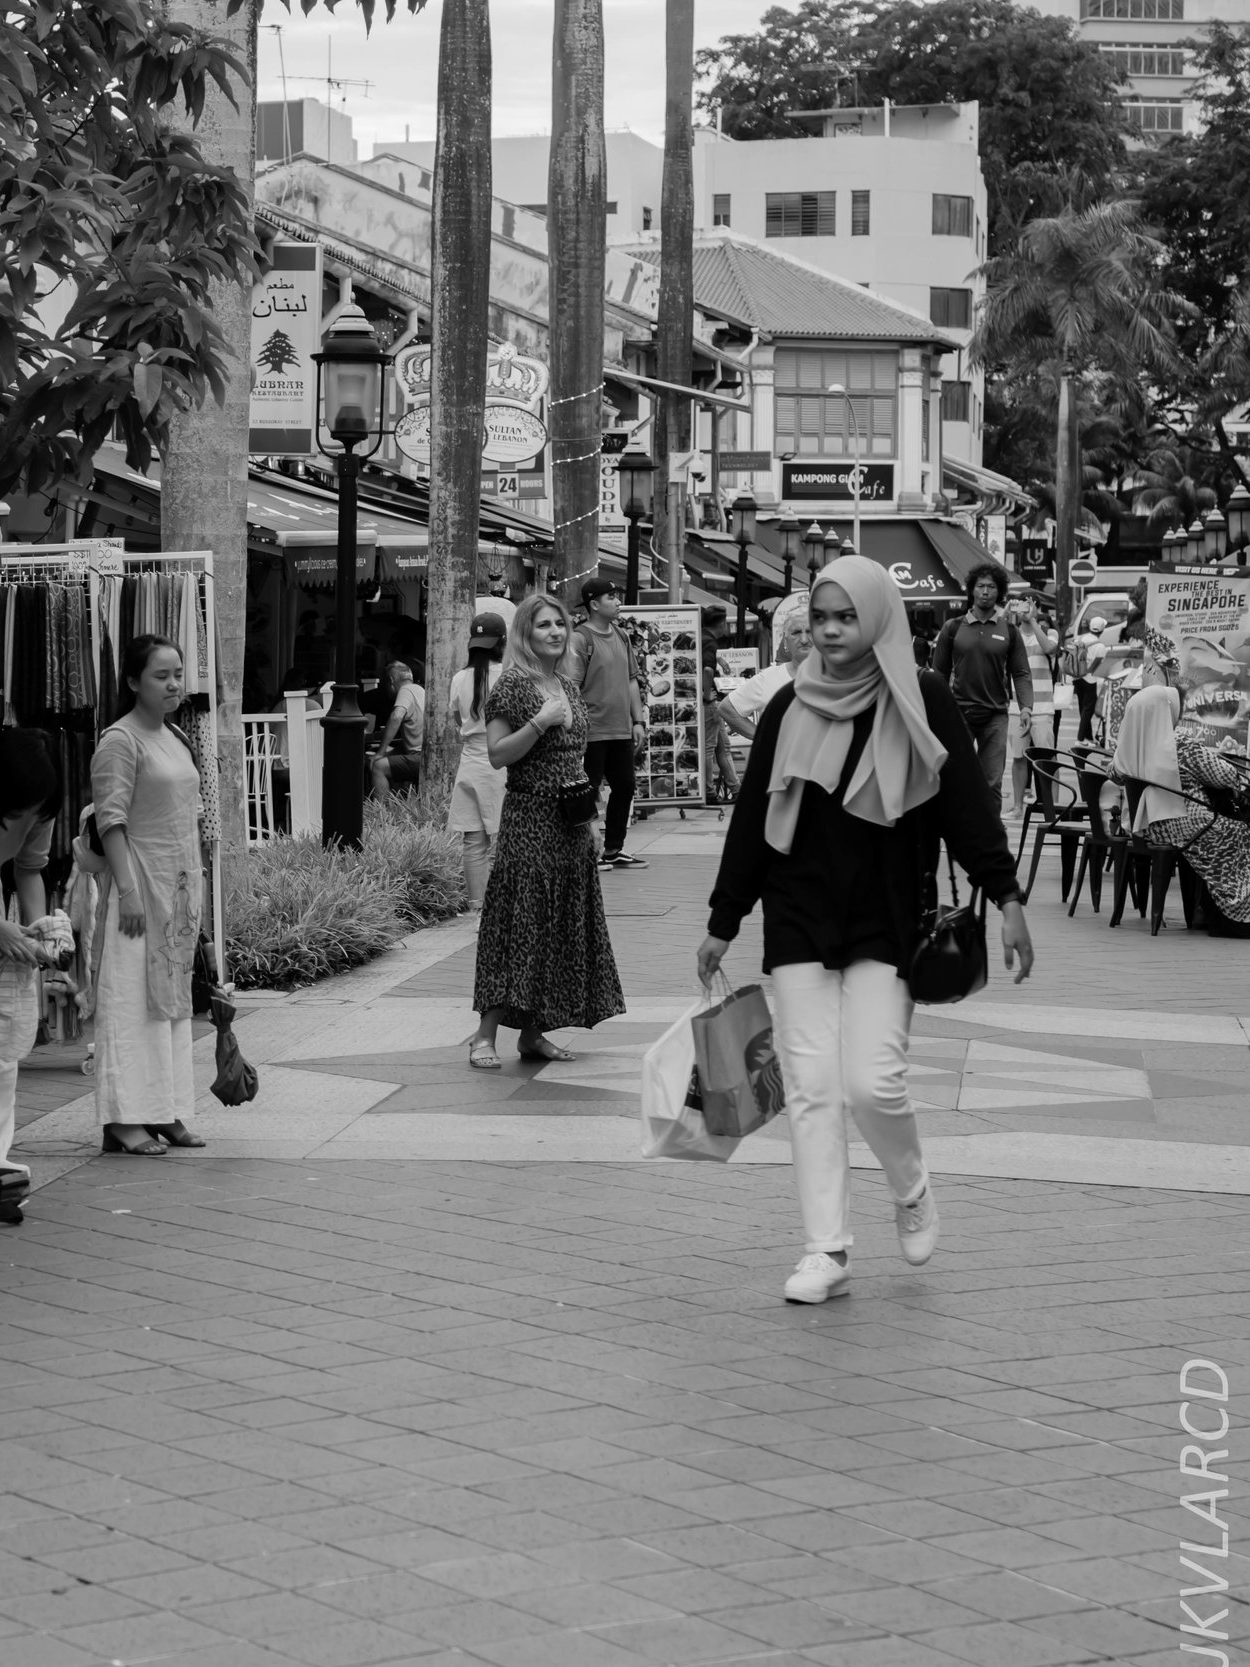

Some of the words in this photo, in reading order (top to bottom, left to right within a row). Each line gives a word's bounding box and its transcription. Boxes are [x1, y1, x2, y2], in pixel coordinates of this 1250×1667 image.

[252, 294, 307, 318] لبنان
[489, 424, 522, 435] SULTAN
[493, 434, 528, 443] LEBANON
[481, 480, 494, 489] PEN
[499, 477, 517, 493] 24
[520, 479, 543, 489] HOURS
[791, 474, 837, 484] KAMPONG
[838, 475, 864, 484] GLAM
[889, 562, 944, 592] Cafe
[1158, 580, 1219, 593] EXPERIENCE
[1206, 589, 1223, 597] BEST
[1168, 594, 1246, 612] SINGAPORE
[1180, 626, 1198, 634] PRICE
[1199, 624, 1217, 633] FROM
